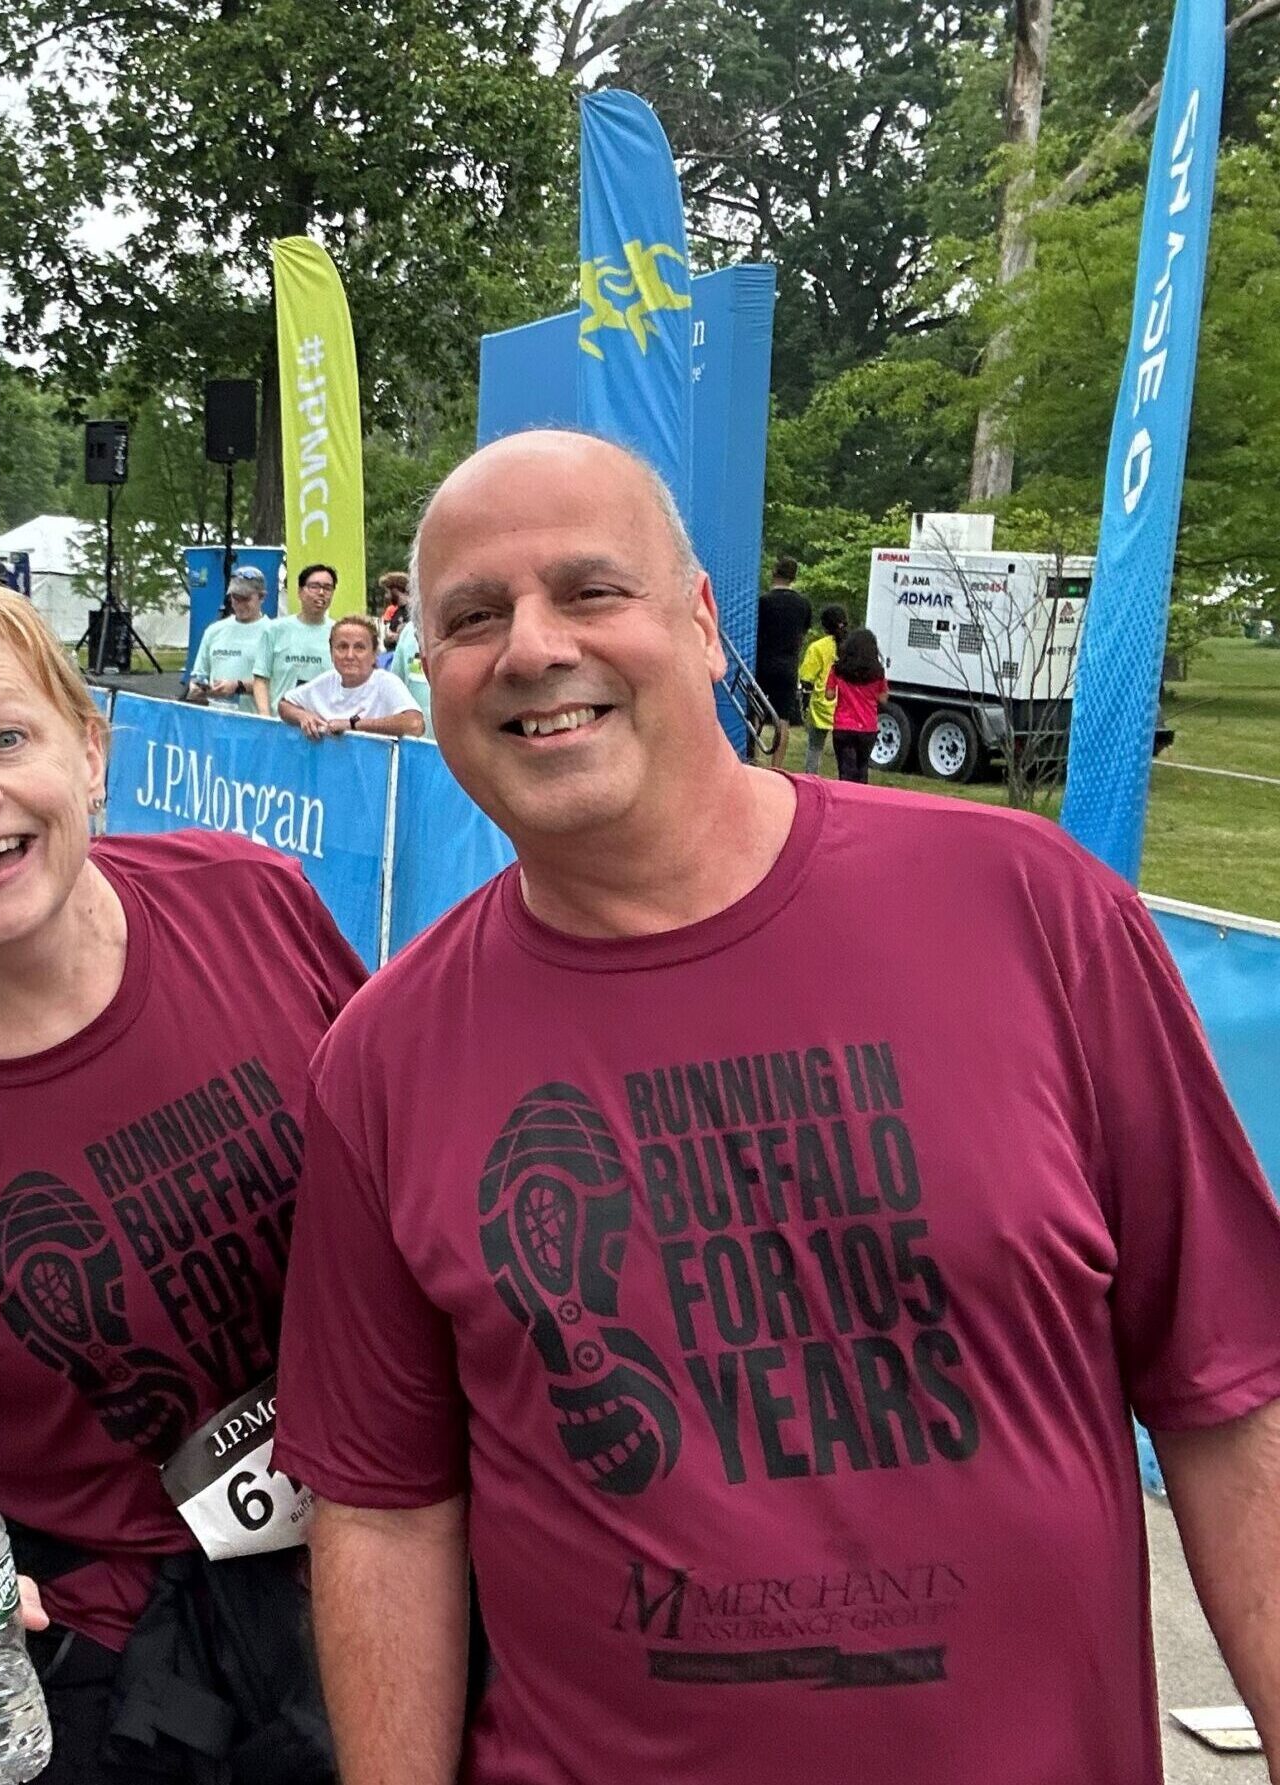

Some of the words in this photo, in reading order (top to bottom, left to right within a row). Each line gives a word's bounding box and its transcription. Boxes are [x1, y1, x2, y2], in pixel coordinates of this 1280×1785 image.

[296, 333, 330, 546] #JPMCC
[877, 552, 910, 563] AIRMAN
[896, 591, 954, 609] ADMAR
[912, 576, 931, 586] ANA
[212, 648, 242, 658] amazon
[284, 654, 323, 665] amazon
[136, 739, 325, 859] J.P.Morgan
[83, 1077, 248, 1198] RUNNING
[229, 1056, 284, 1117] IN
[624, 1046, 843, 1140] RUNNING
[844, 1041, 905, 1113] IN
[111, 1109, 306, 1271] BUFFALO
[638, 1114, 922, 1237] BUFFALO
[150, 1231, 258, 1347] FOR
[660, 1229, 813, 1351] FOR
[808, 1218, 950, 1336] 105
[684, 1328, 981, 1486] YEARS
[692, 1615, 843, 1643] INSURANCE
[850, 1602, 948, 1633] GROUP
